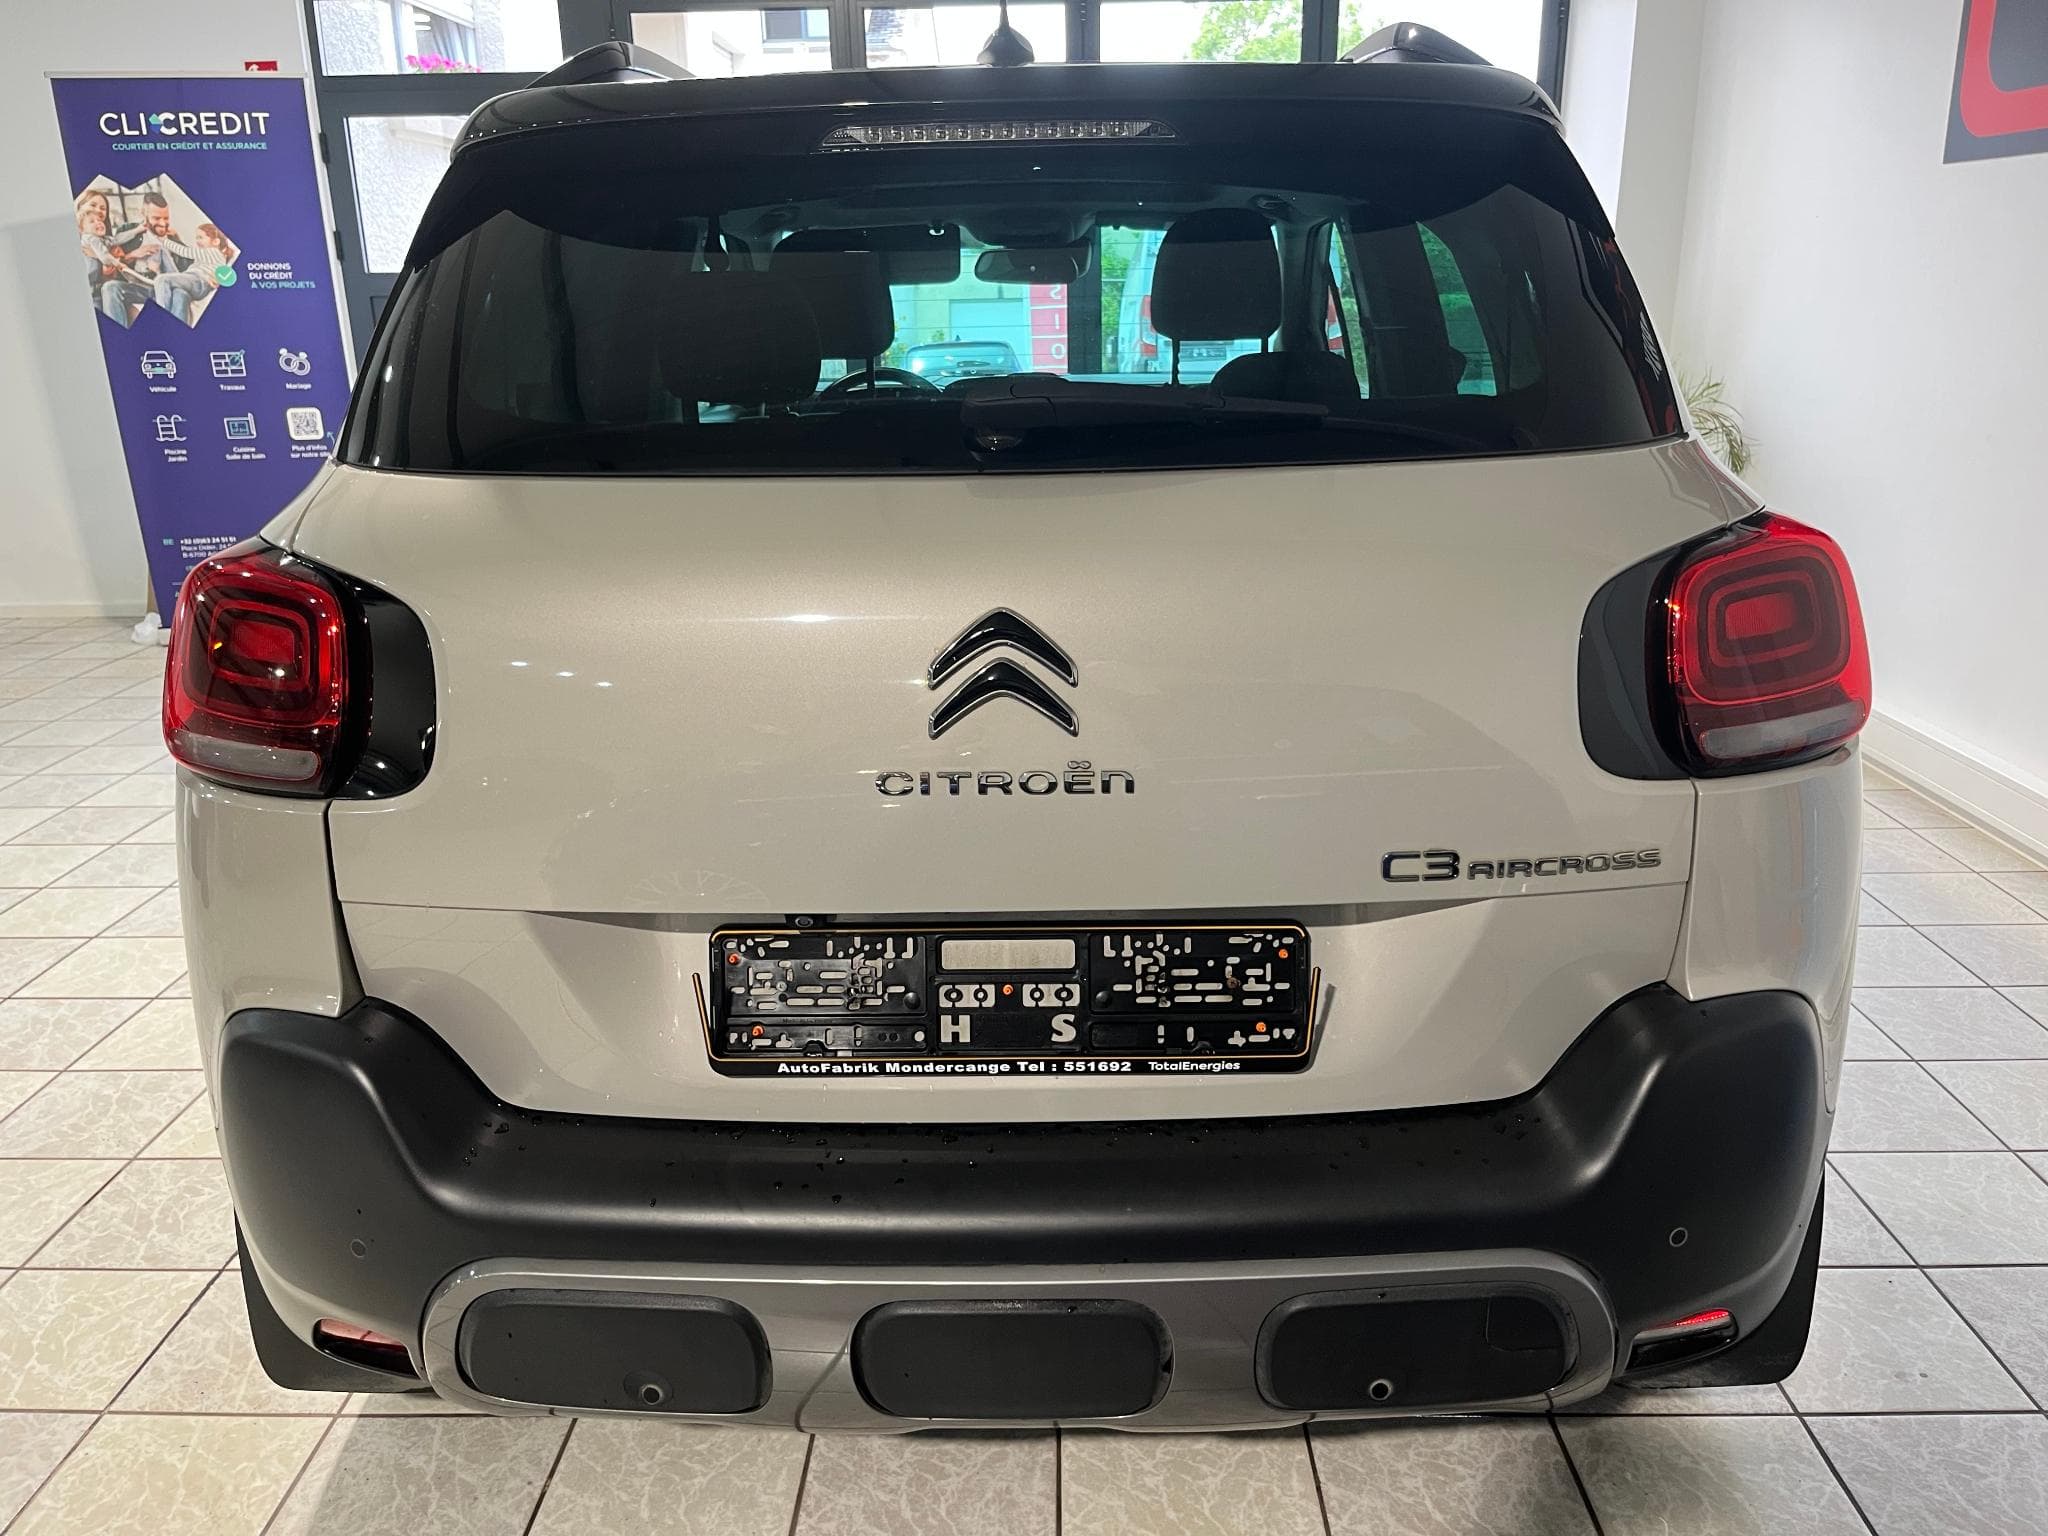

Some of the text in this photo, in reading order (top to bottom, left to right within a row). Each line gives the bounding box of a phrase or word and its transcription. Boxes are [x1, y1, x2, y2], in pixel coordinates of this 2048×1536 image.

[112, 141, 267, 151] COURTIER EN CRÉDIT ET ASSURANCE
[247, 262, 291, 271] DONNONS
[249, 272, 262, 280] DU
[259, 281, 278, 289] VOS
[279, 280, 316, 289] PROJETS
[285, 382, 312, 391] Mariage
[1381, 848, 1662, 882] C3 AIRCROSS
[777, 1062, 880, 1074] AutoFabrik
[885, 1062, 1011, 1074] Mondercange
[1016, 1061, 1045, 1072] Tel
[1063, 1061, 1132, 1072] 551692
[1147, 1060, 1241, 1073] TotalEnergies
